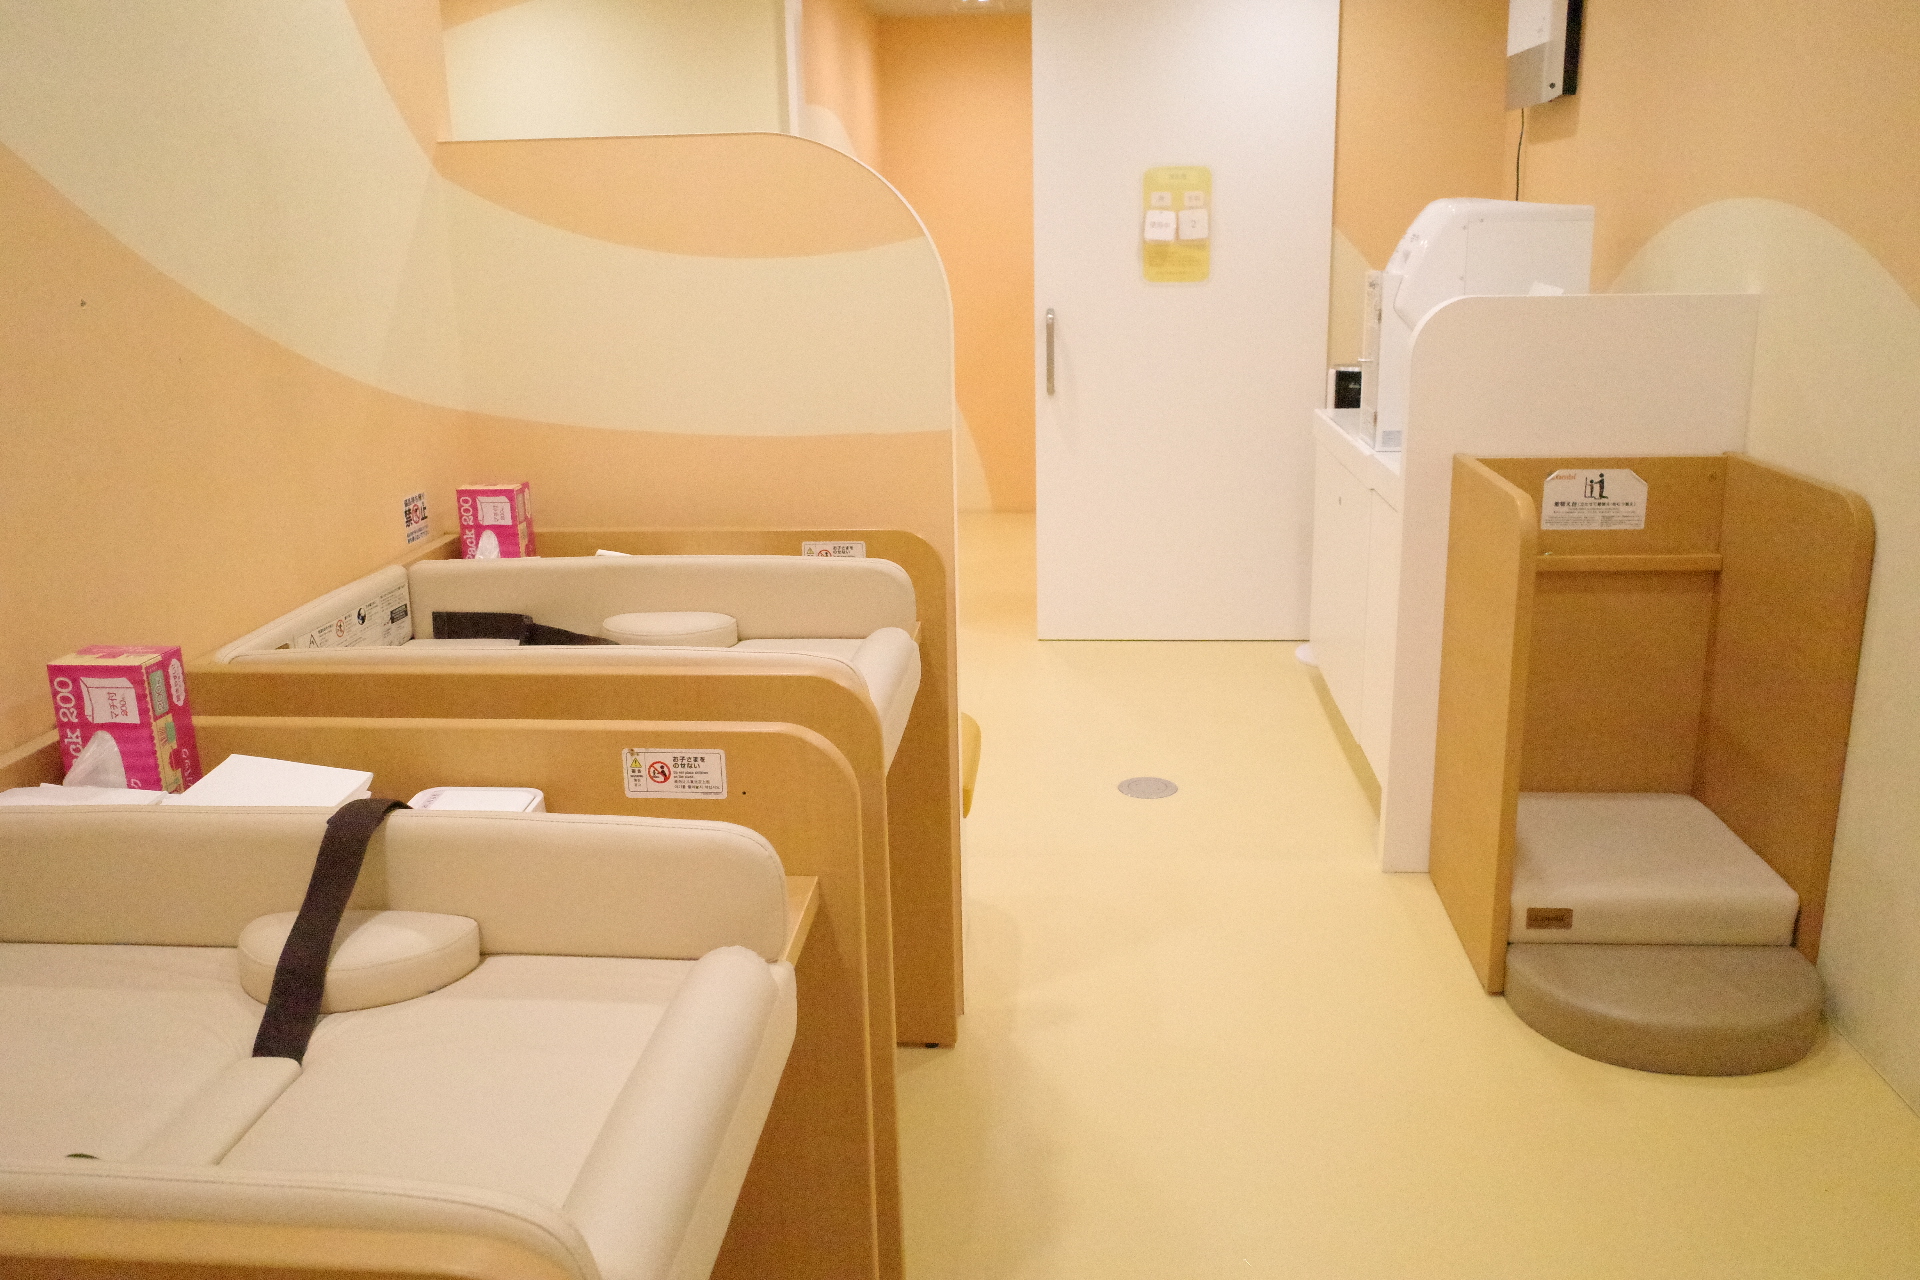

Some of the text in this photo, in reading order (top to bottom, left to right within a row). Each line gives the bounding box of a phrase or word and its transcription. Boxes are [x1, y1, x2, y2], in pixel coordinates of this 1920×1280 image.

[460, 496, 474, 525] 200
[53, 677, 79, 723] 200
[107, 692, 119, 719] マチ付
